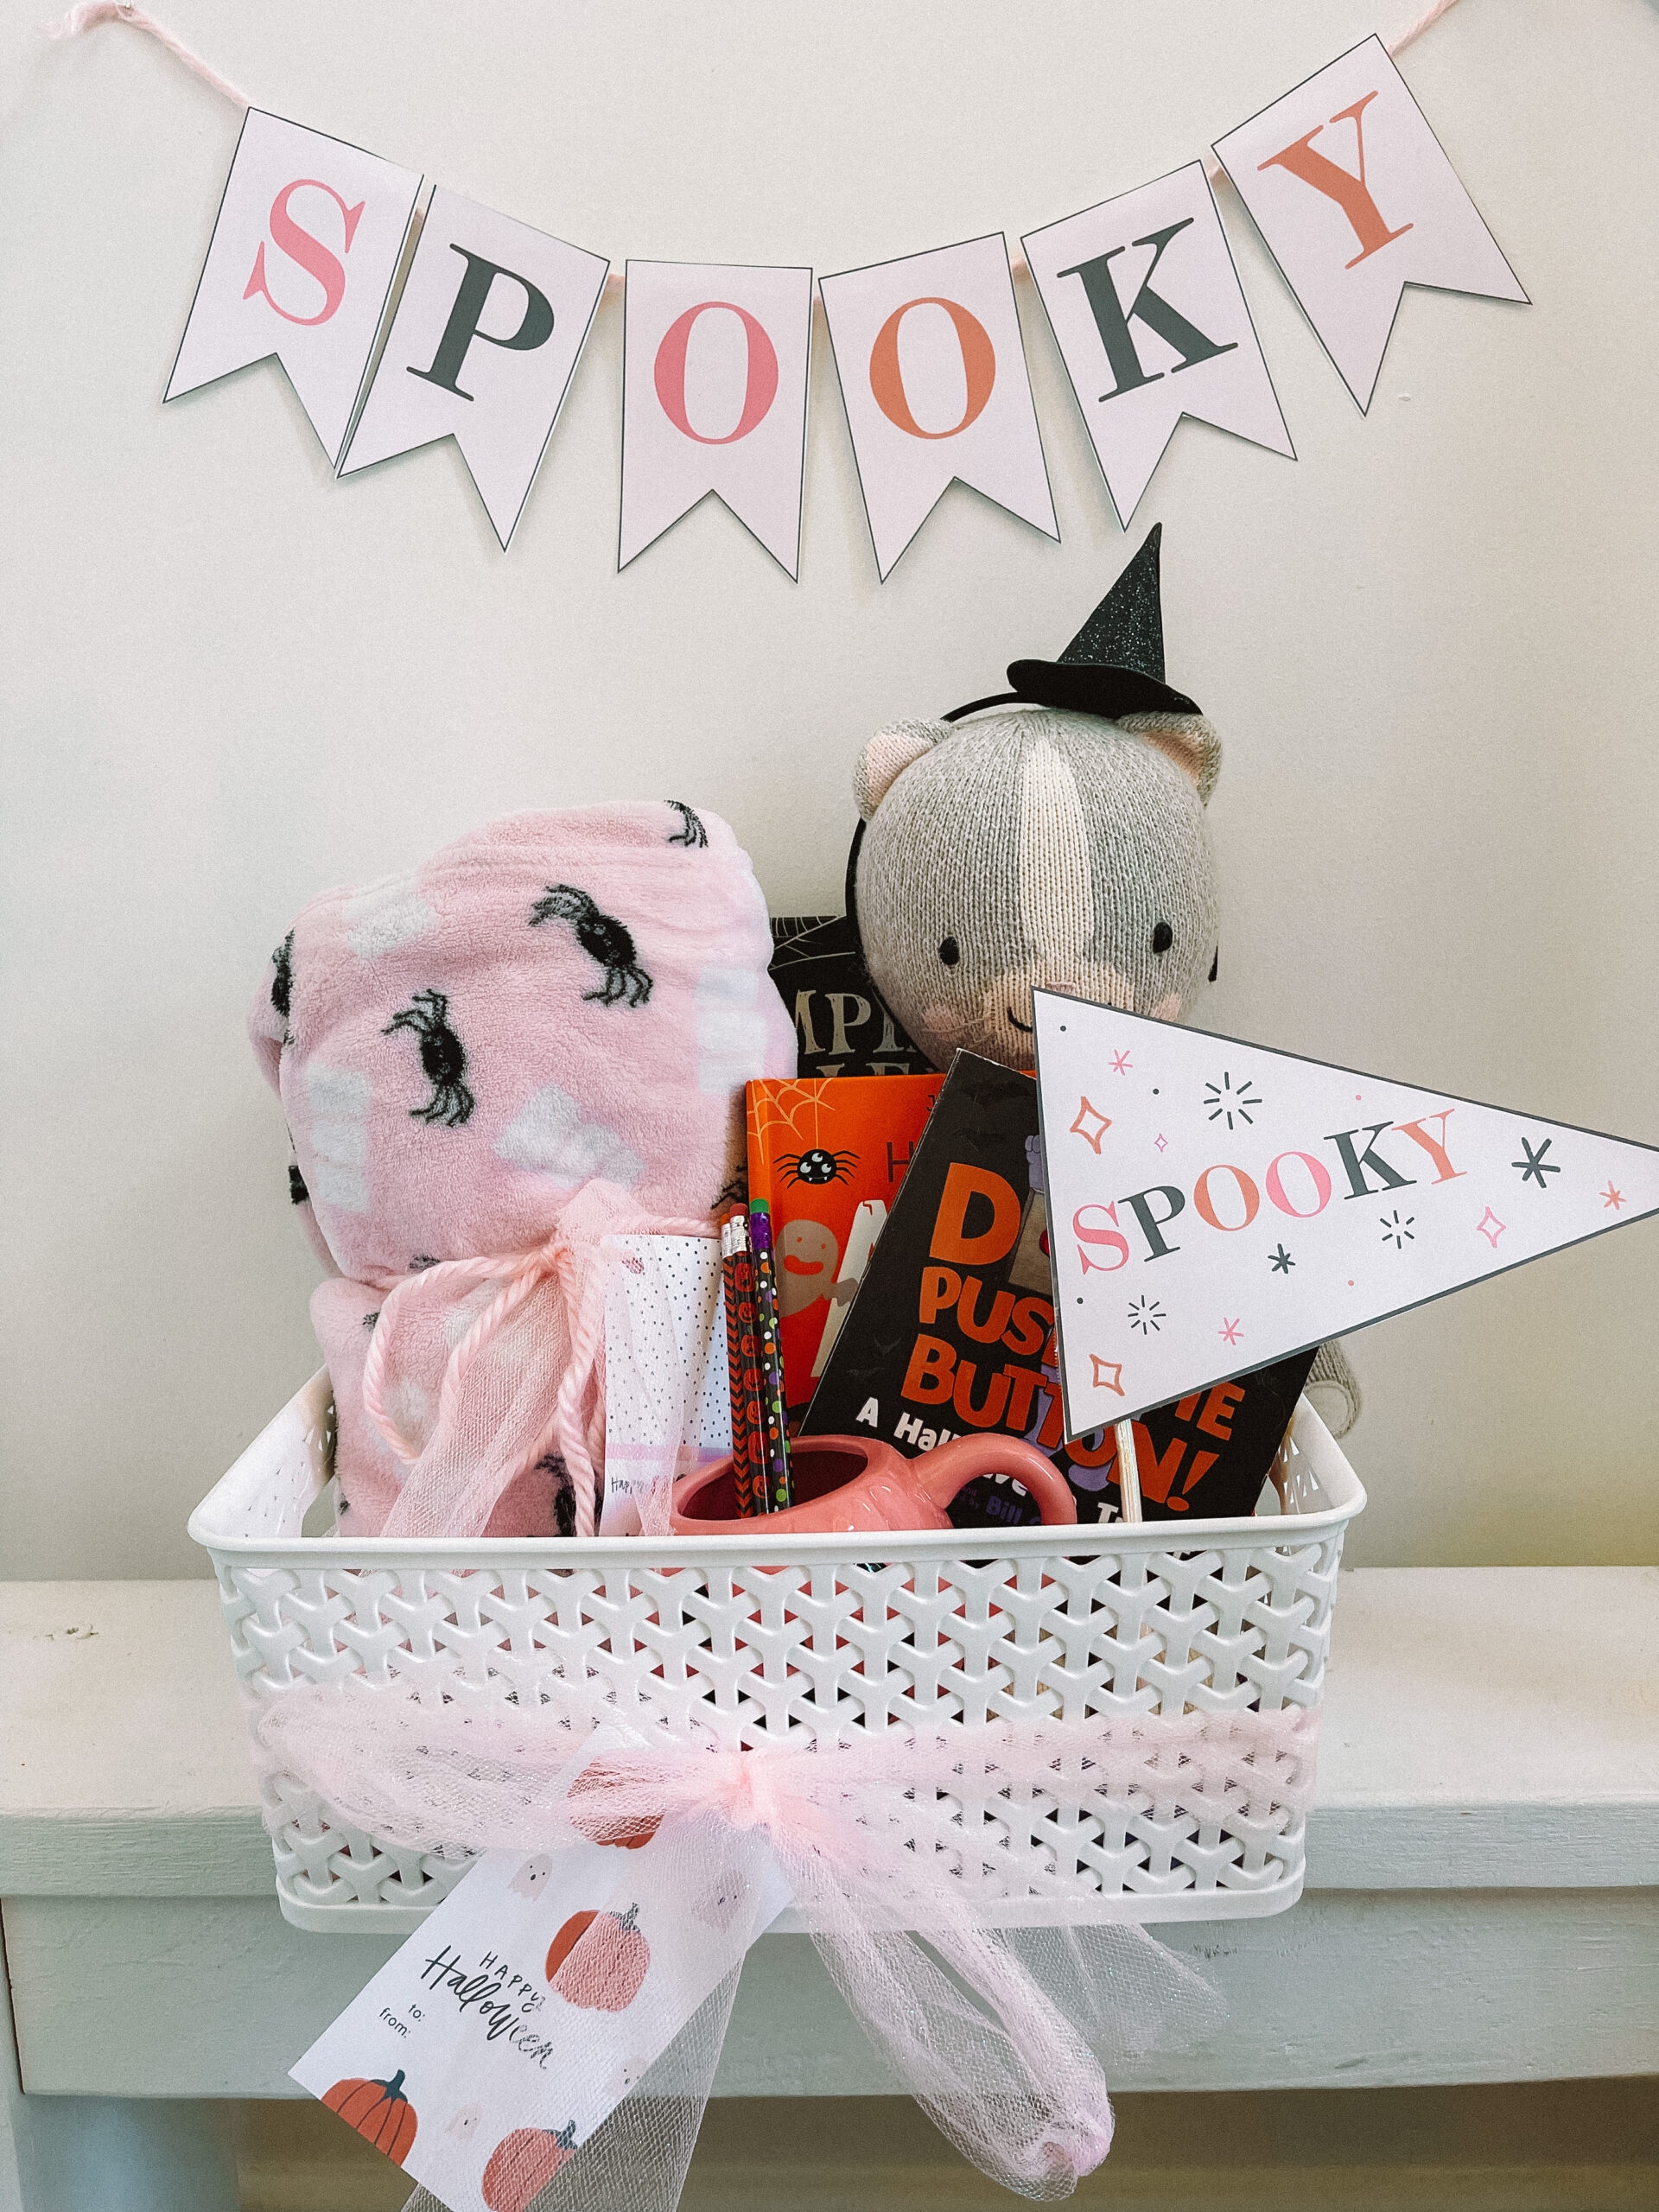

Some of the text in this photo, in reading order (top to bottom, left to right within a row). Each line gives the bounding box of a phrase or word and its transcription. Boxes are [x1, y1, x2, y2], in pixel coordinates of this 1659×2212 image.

[243, 91, 1414, 445] SPOOKY
[1072, 1109, 1467, 1274] SPOOKY
[918, 1267, 1058, 1367] PUS
[855, 1397, 879, 1427] A
[985, 1495, 1023, 1524] Bill
[421, 1945, 553, 2069] Halloween
[480, 1951, 545, 2012] HAPPY
[379, 2007, 411, 2038] from:
[408, 2004, 425, 2022] to:
